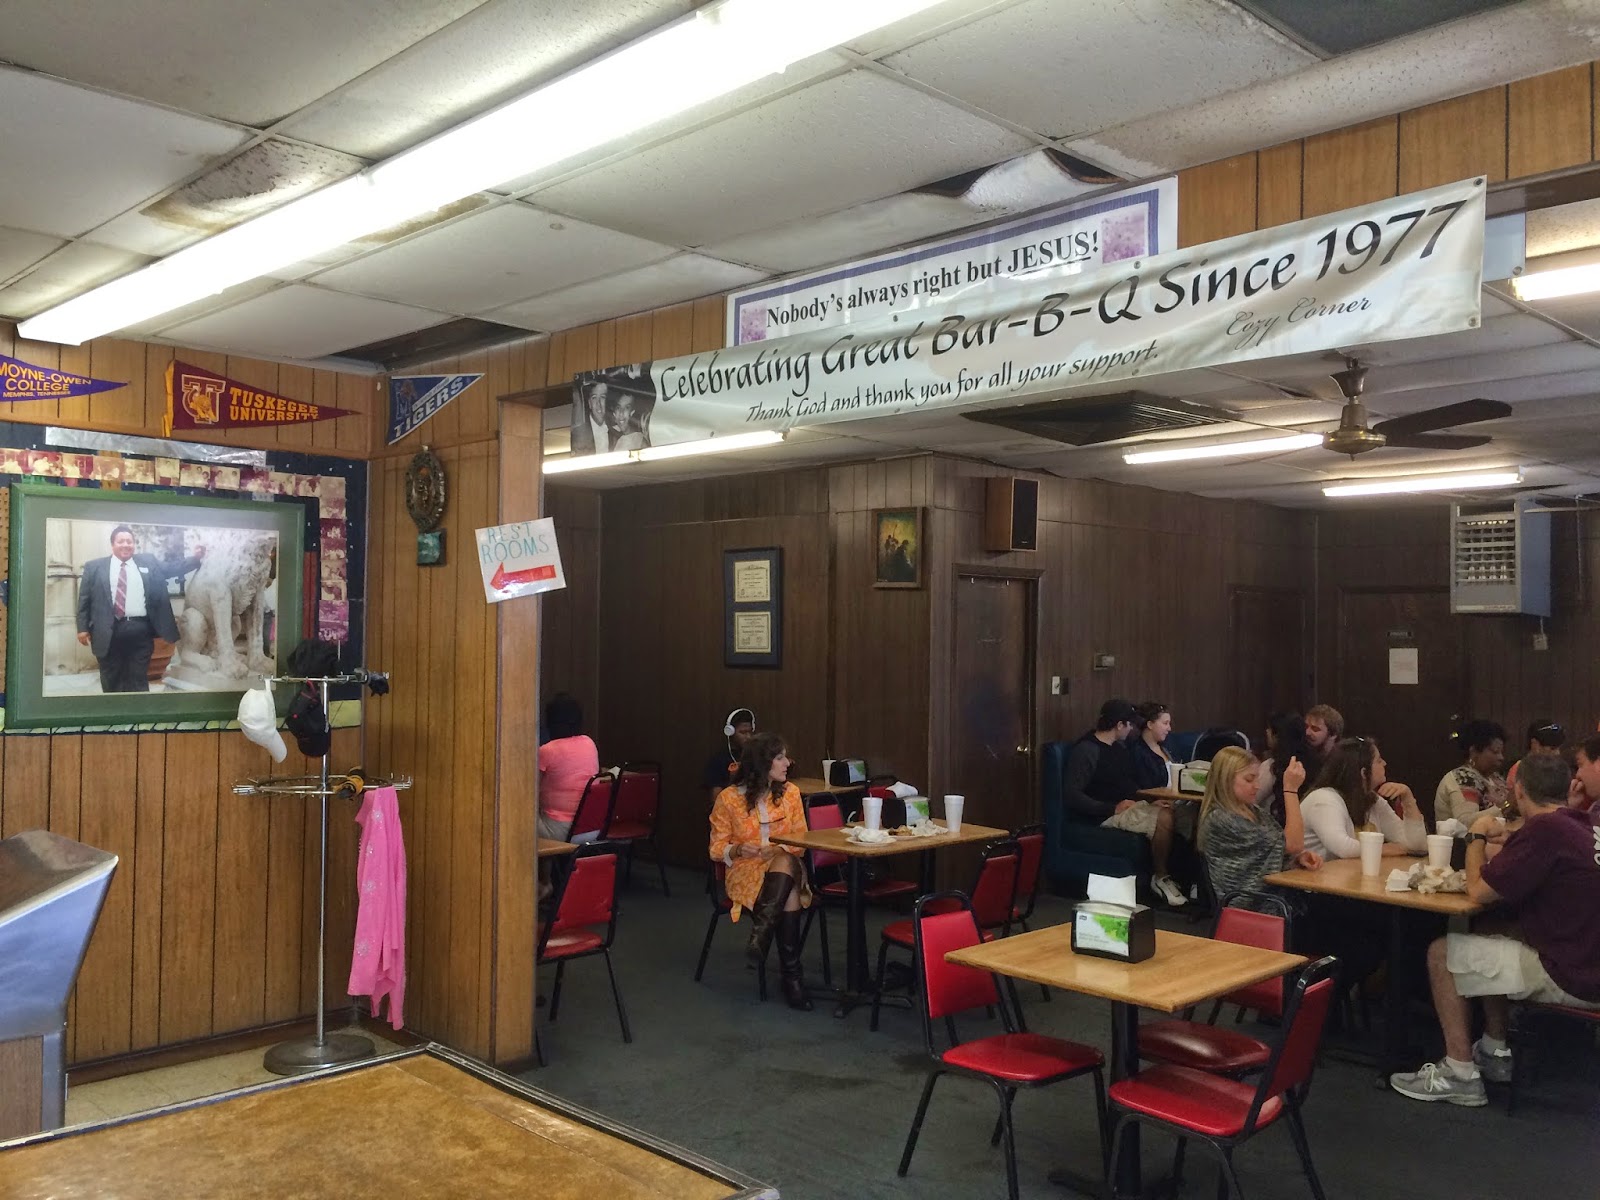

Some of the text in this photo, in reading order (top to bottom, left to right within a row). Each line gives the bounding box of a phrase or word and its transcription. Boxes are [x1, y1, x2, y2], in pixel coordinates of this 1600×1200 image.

[766, 230, 1099, 328] Nobody's always right but JESUS!
[660, 199, 1468, 403] Celebrating Great Bar-B-Q Since 1977
[1226, 297, 1373, 350] Cozy Corner
[5, 378, 70, 391] COLLEGE
[229, 386, 319, 414] TUSKEGEE
[745, 339, 1159, 422] Thank God and thank you for all your support.
[229, 405, 319, 421] UNIVERSITY
[393, 377, 463, 437] TIGERS
[481, 534, 549, 564] ROOMS
[487, 522, 532, 544] REST
